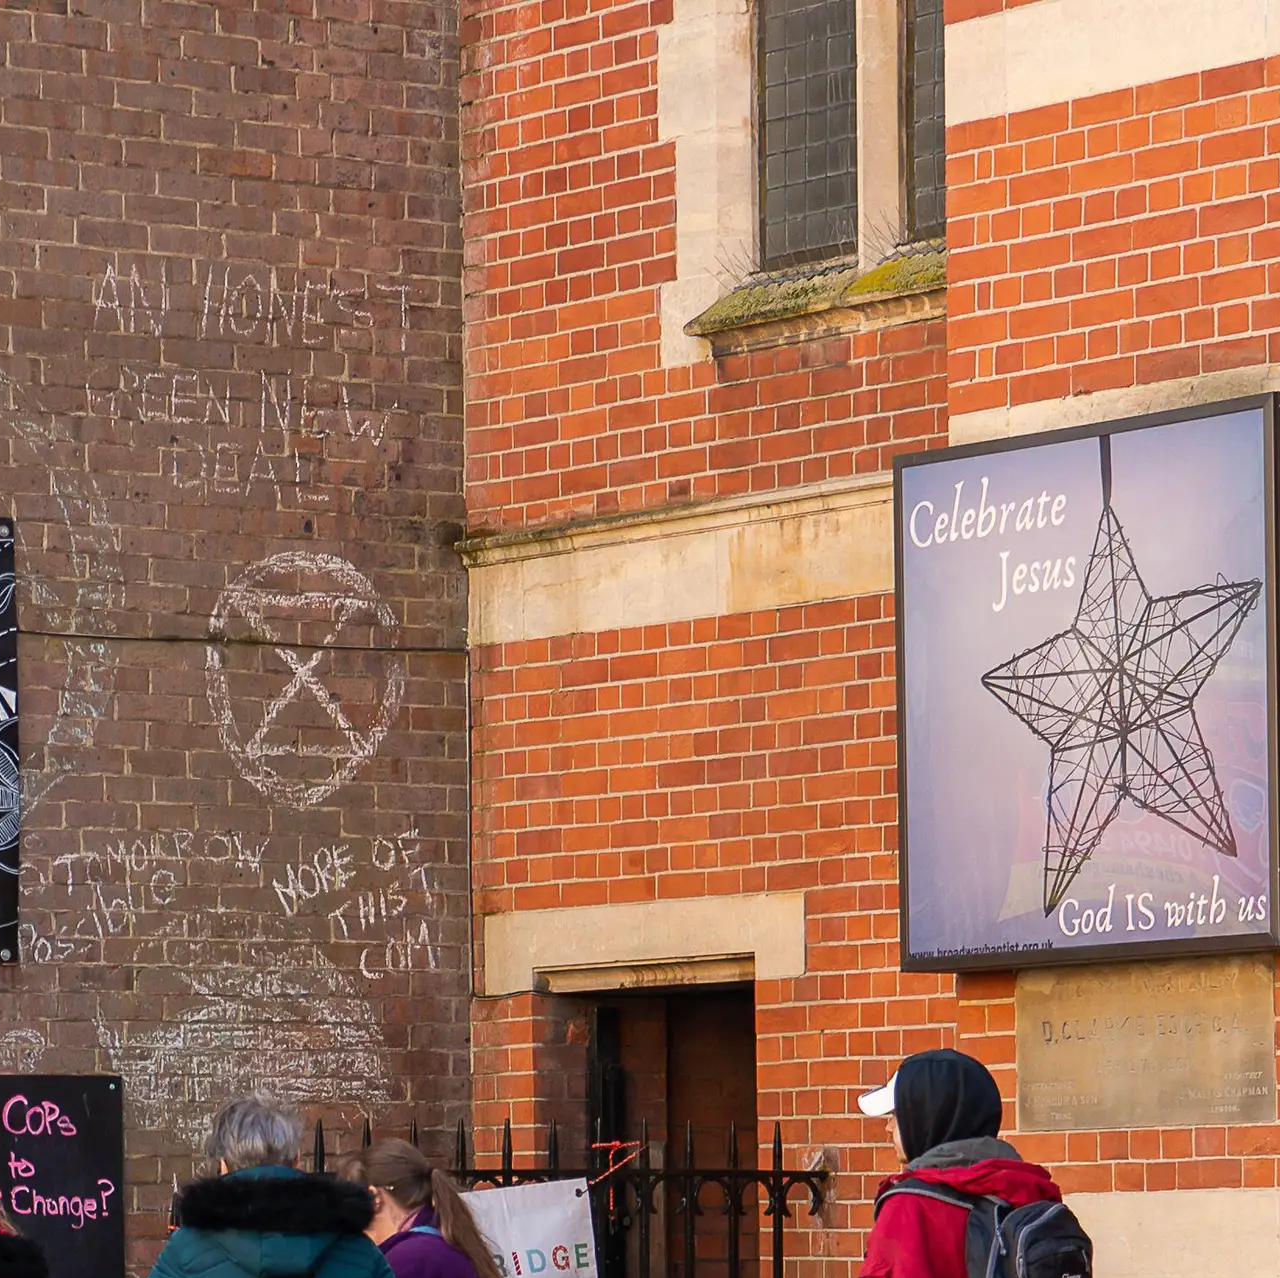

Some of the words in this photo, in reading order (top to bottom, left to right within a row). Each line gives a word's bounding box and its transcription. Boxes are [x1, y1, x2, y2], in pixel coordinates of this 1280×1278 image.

[260, 368, 399, 447] NEW
[909, 476, 1067, 549] Celebrate
[993, 549, 1077, 613] Jesus
[1058, 884, 1114, 937] God
[1125, 891, 1154, 932] IS
[1164, 875, 1225, 927] with
[1238, 892, 1268, 921] us
[8, 1151, 36, 1179] to
[10, 1178, 116, 1230] Change?
